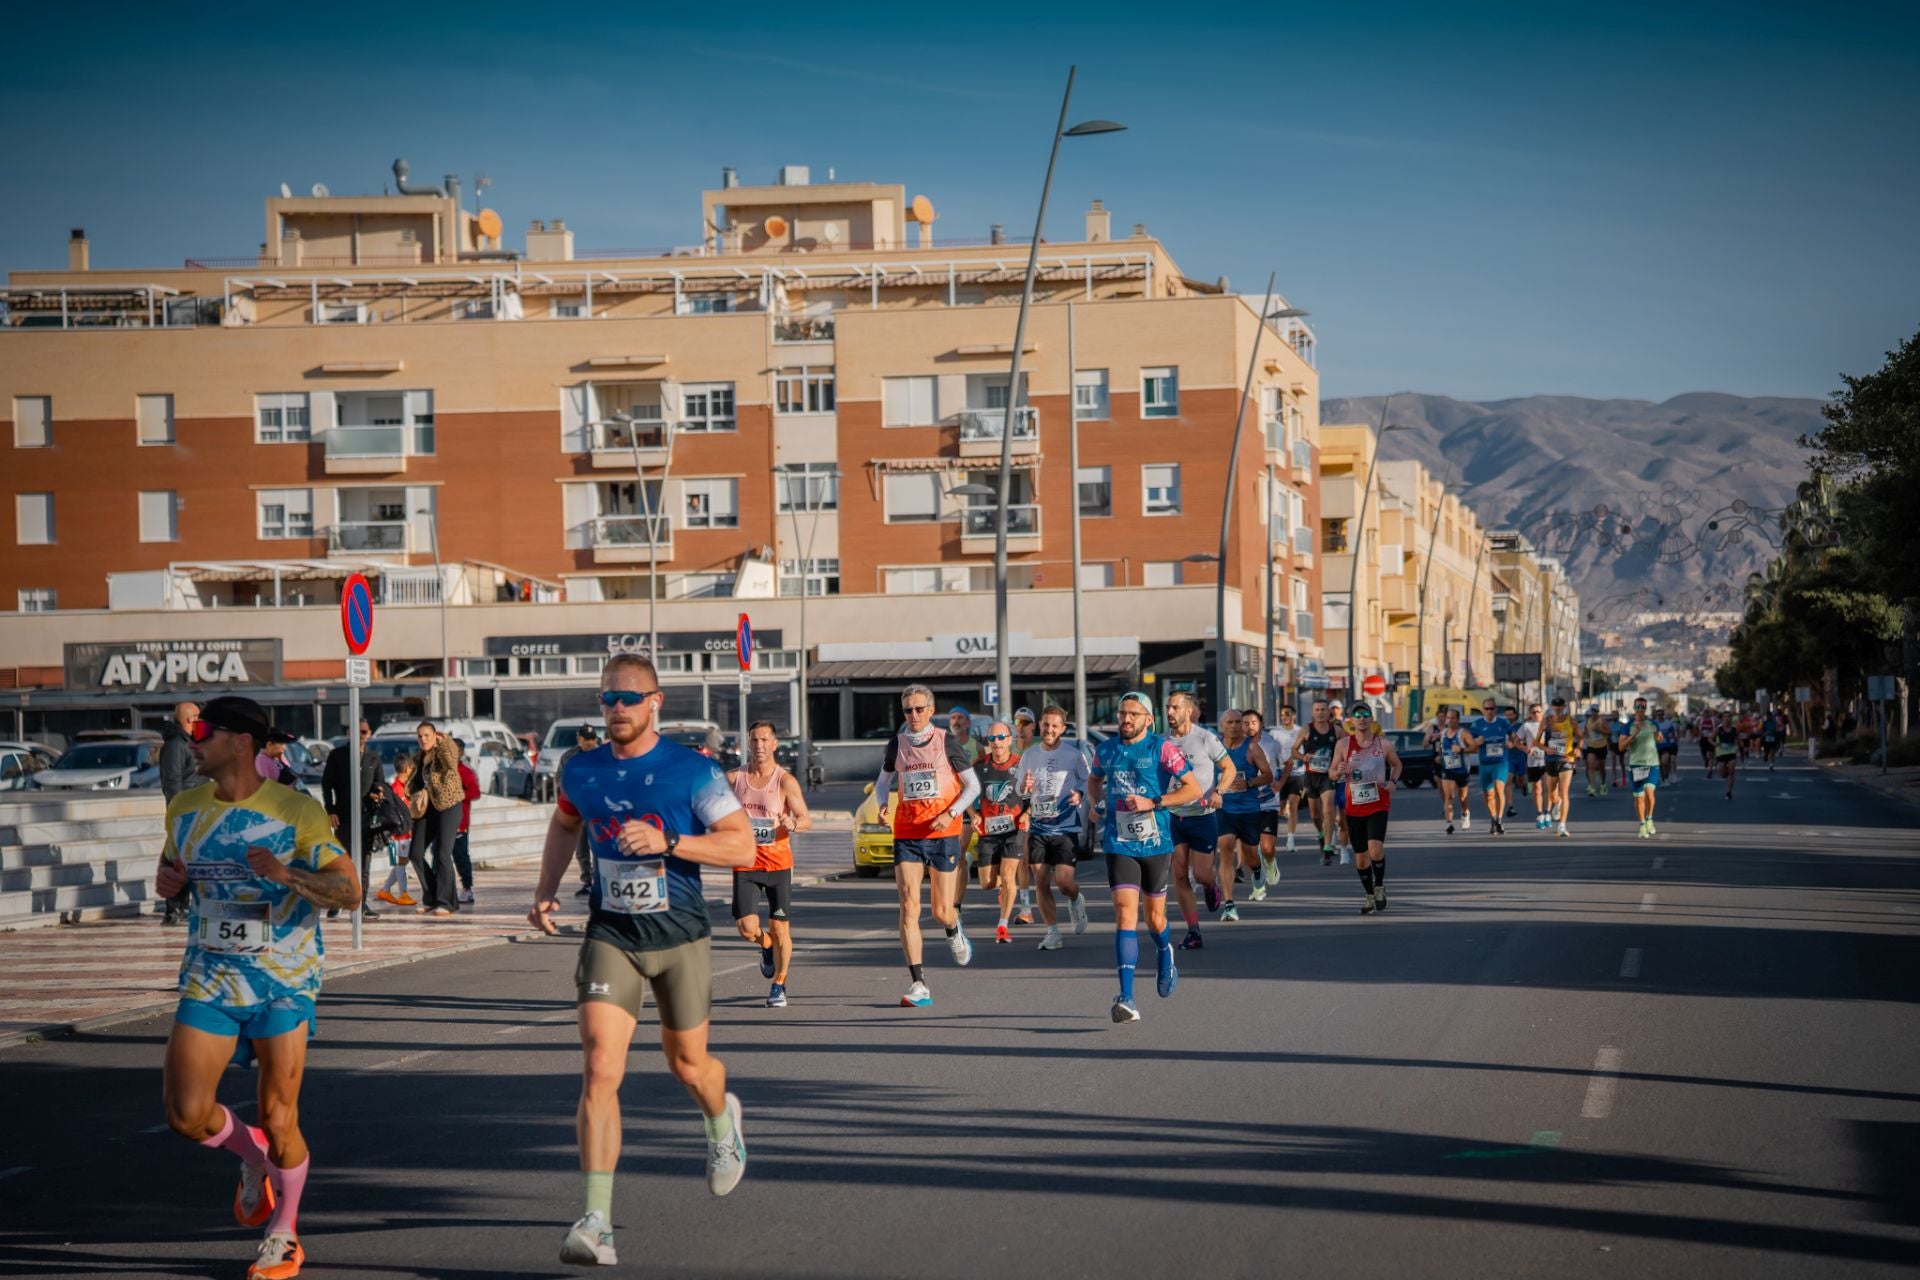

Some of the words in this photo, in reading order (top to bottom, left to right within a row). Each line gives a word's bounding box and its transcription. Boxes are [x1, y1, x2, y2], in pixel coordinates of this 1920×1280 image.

[135, 642, 169, 652] TAPAS
[172, 642, 194, 651] BAR
[206, 641, 242, 651] COFFEE
[511, 644, 560, 655] COFFEE
[705, 638, 763, 650] COCKIL
[956, 637, 998, 654] QAL
[905, 763, 935, 771] MOTRIL
[908, 781, 931, 792] 129
[1034, 802, 1050, 811] 137
[1127, 822, 1144, 834] 65
[610, 881, 652, 899] 642
[218, 921, 248, 941] 54
